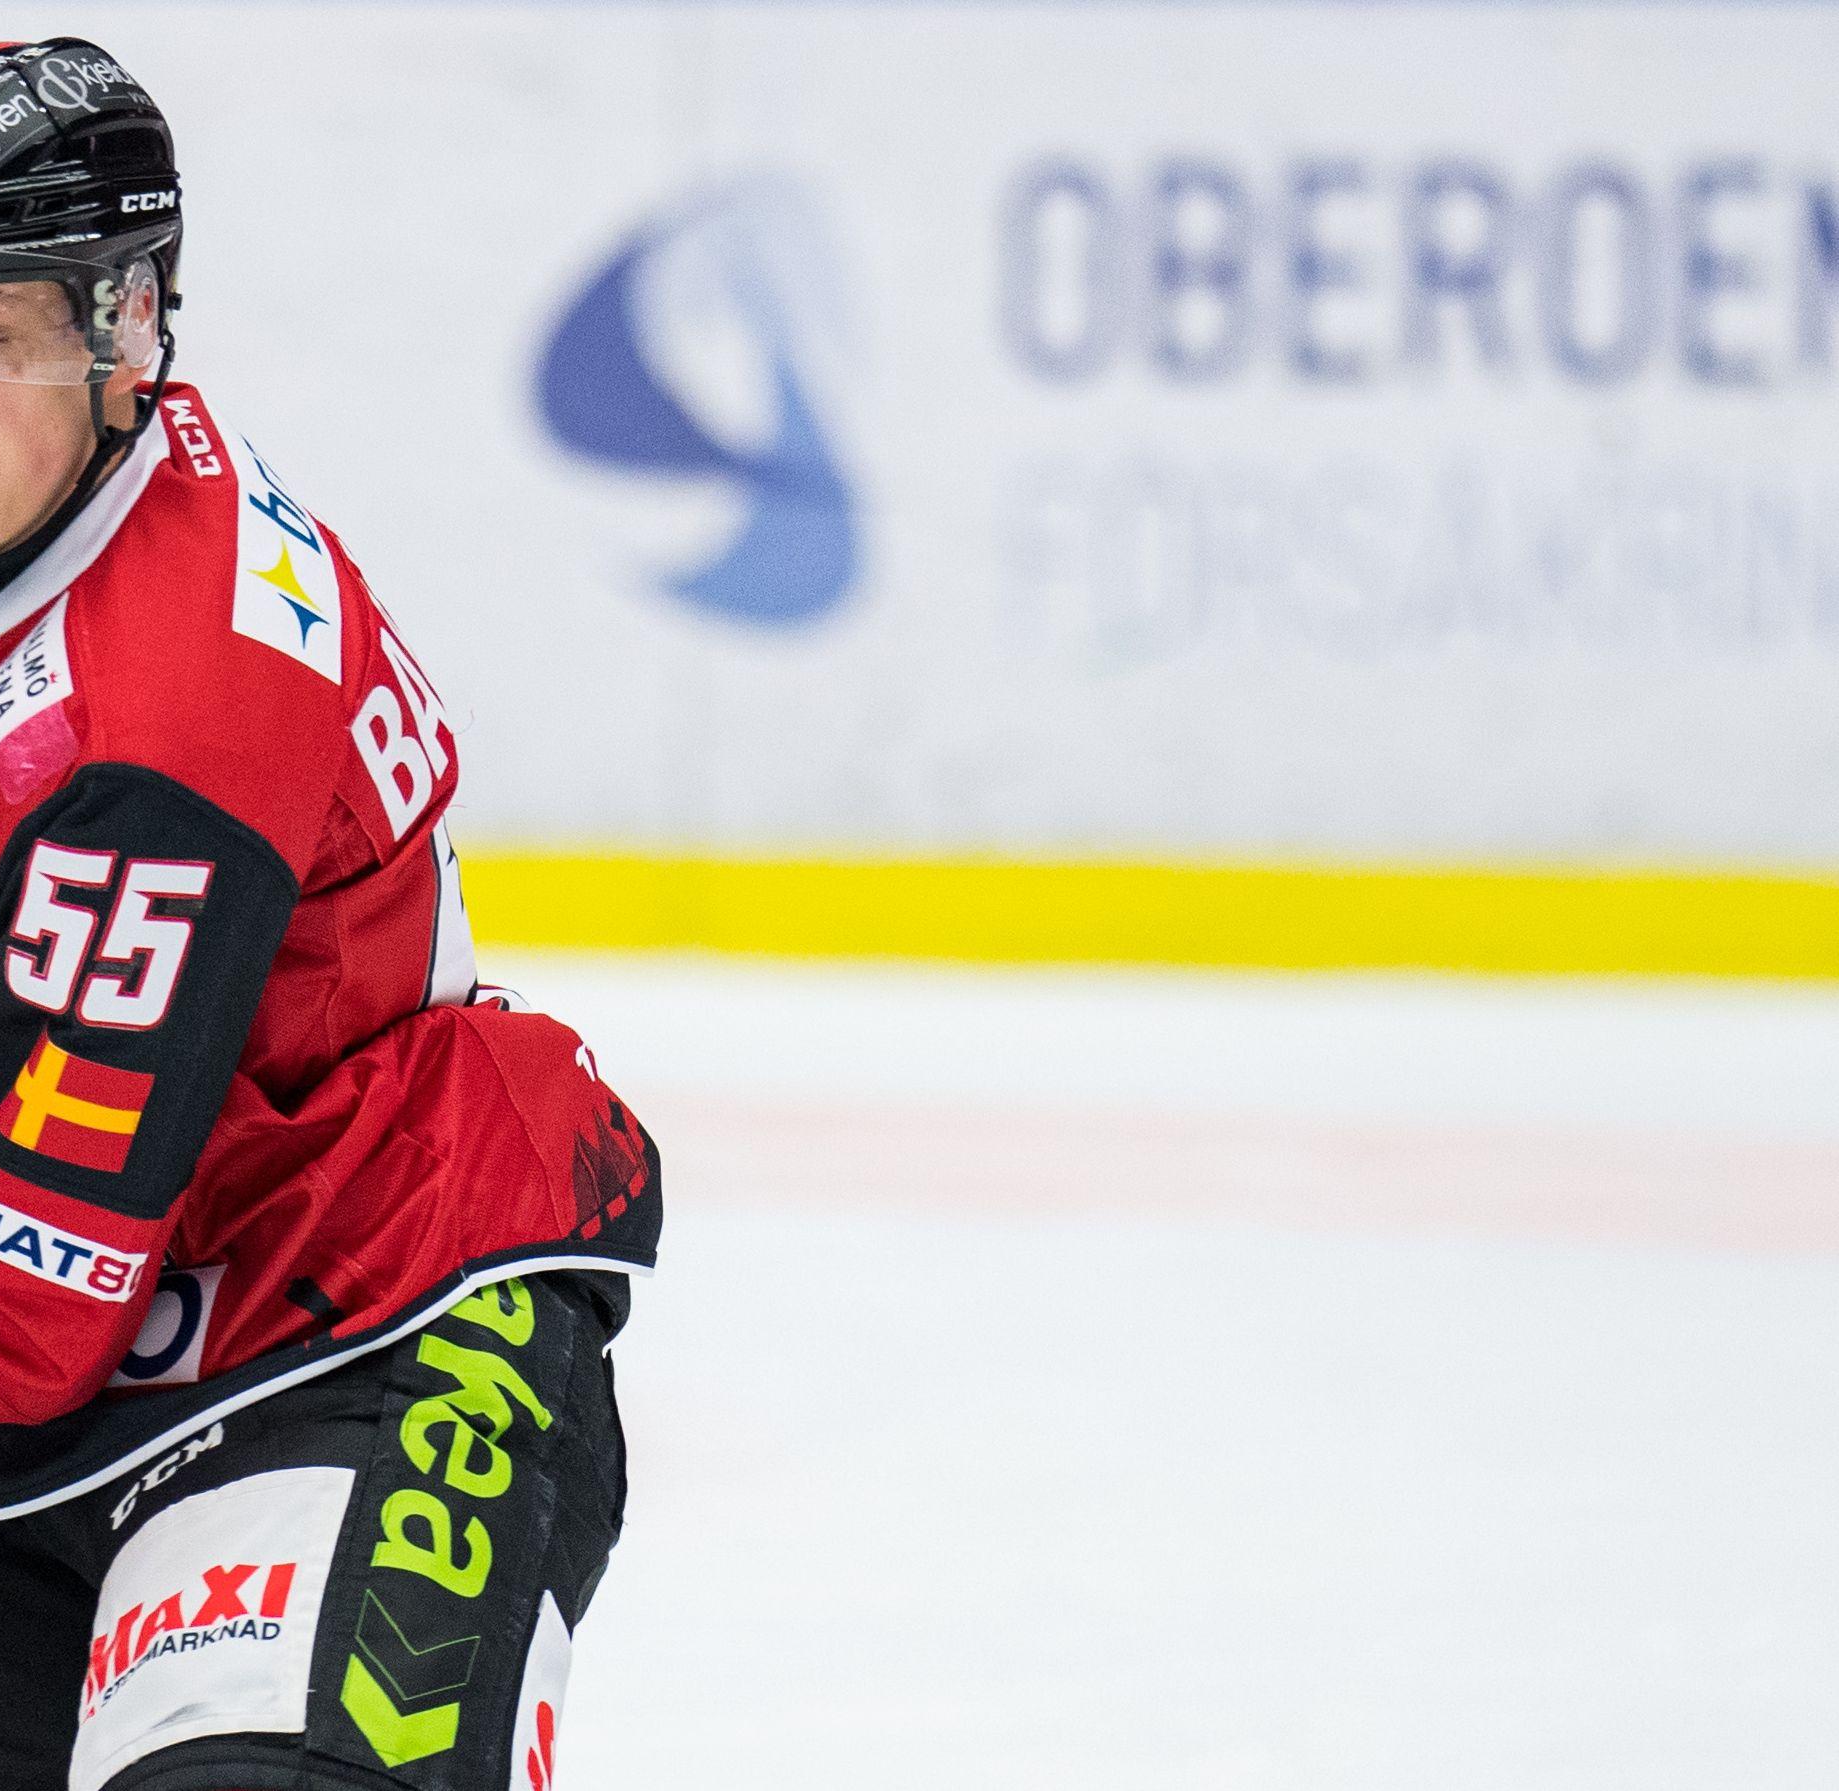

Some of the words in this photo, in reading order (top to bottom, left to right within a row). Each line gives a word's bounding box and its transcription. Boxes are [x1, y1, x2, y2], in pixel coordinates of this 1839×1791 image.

[36, 57, 101, 114] &
[120, 190, 177, 214] CCM
[164, 399, 223, 478] CCM
[5, 838, 215, 1031] 55
[111, 1421, 224, 1530] CCM
